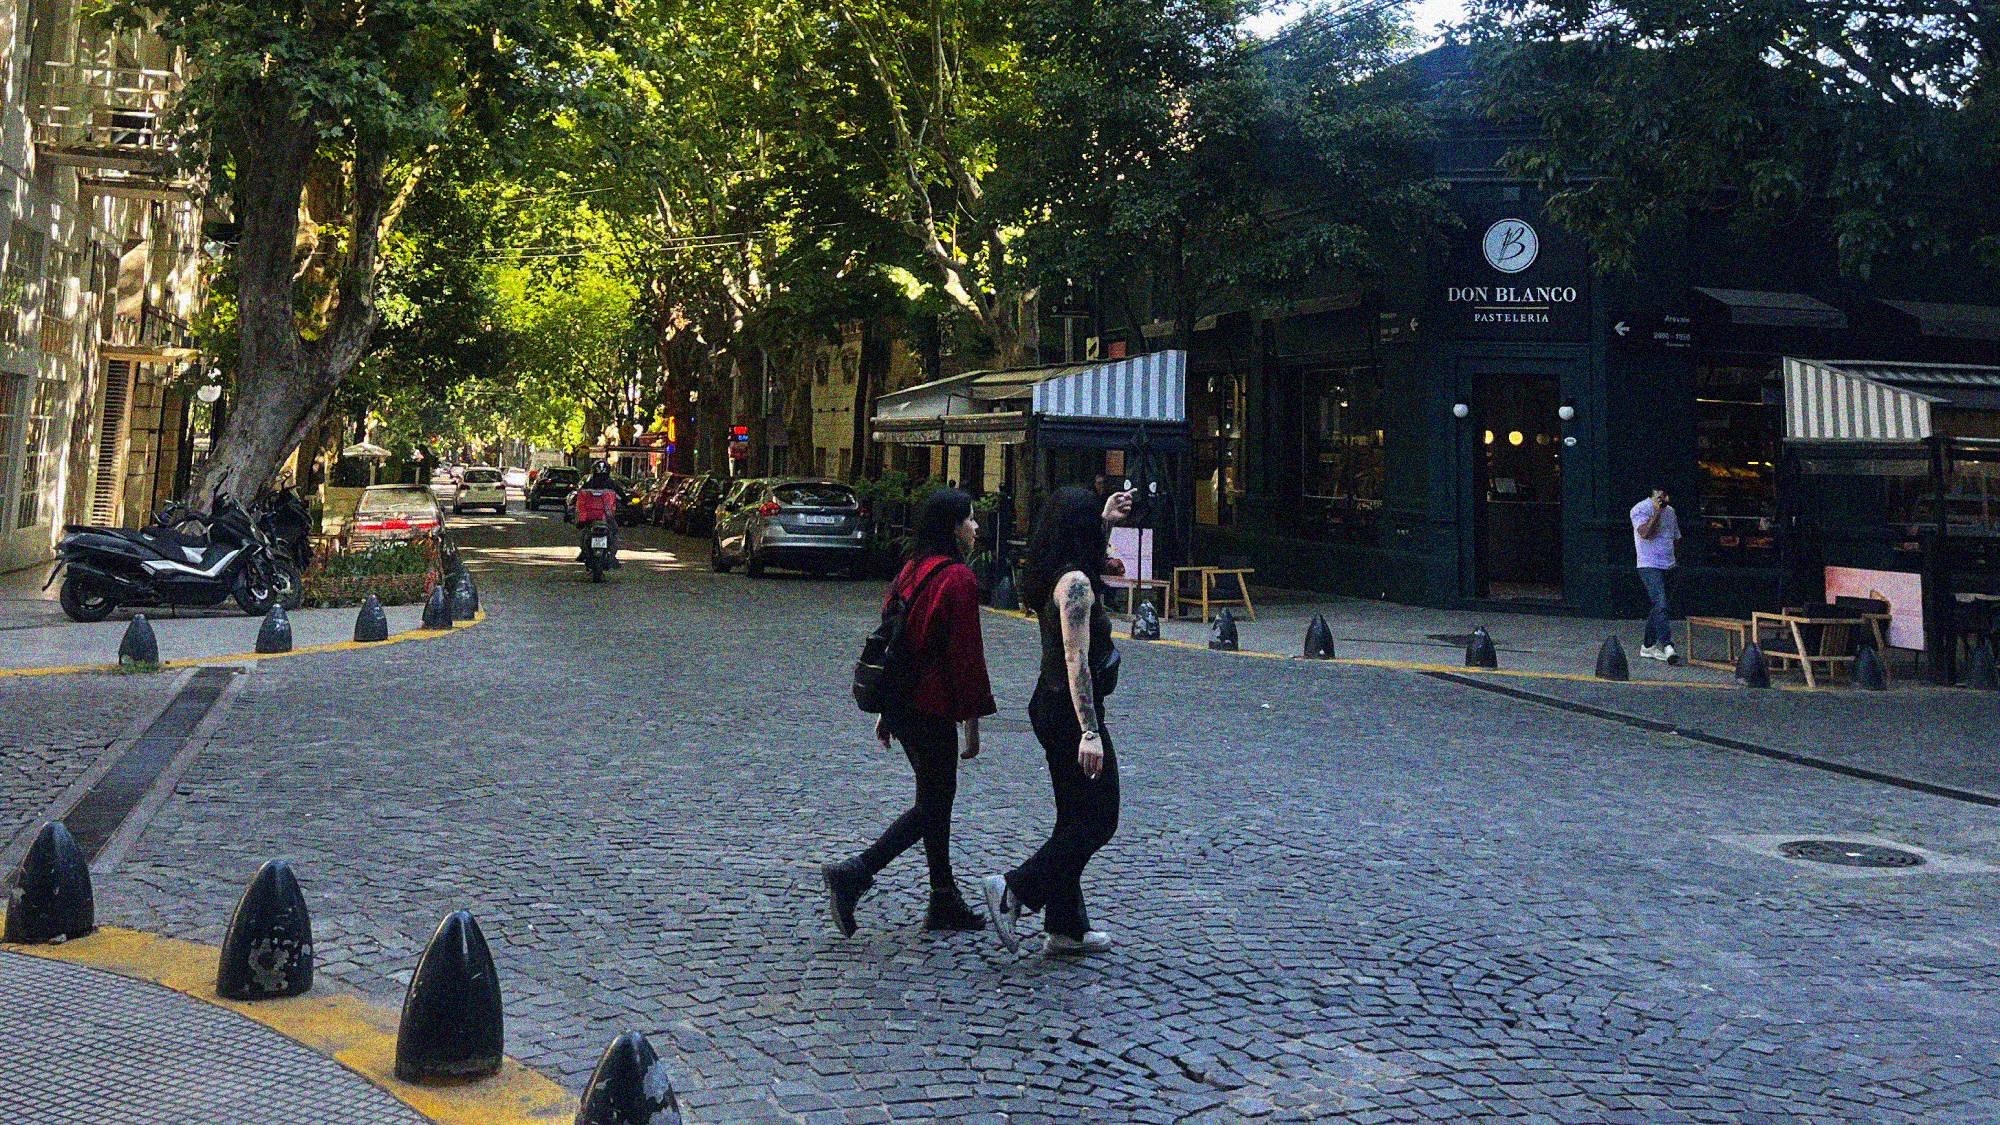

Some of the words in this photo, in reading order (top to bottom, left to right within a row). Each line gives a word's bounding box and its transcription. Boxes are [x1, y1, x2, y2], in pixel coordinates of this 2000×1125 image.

[1447, 286, 1489, 302] DON
[1496, 286, 1577, 302] BLANCO
[1474, 313, 1549, 323] PASTELERIA
